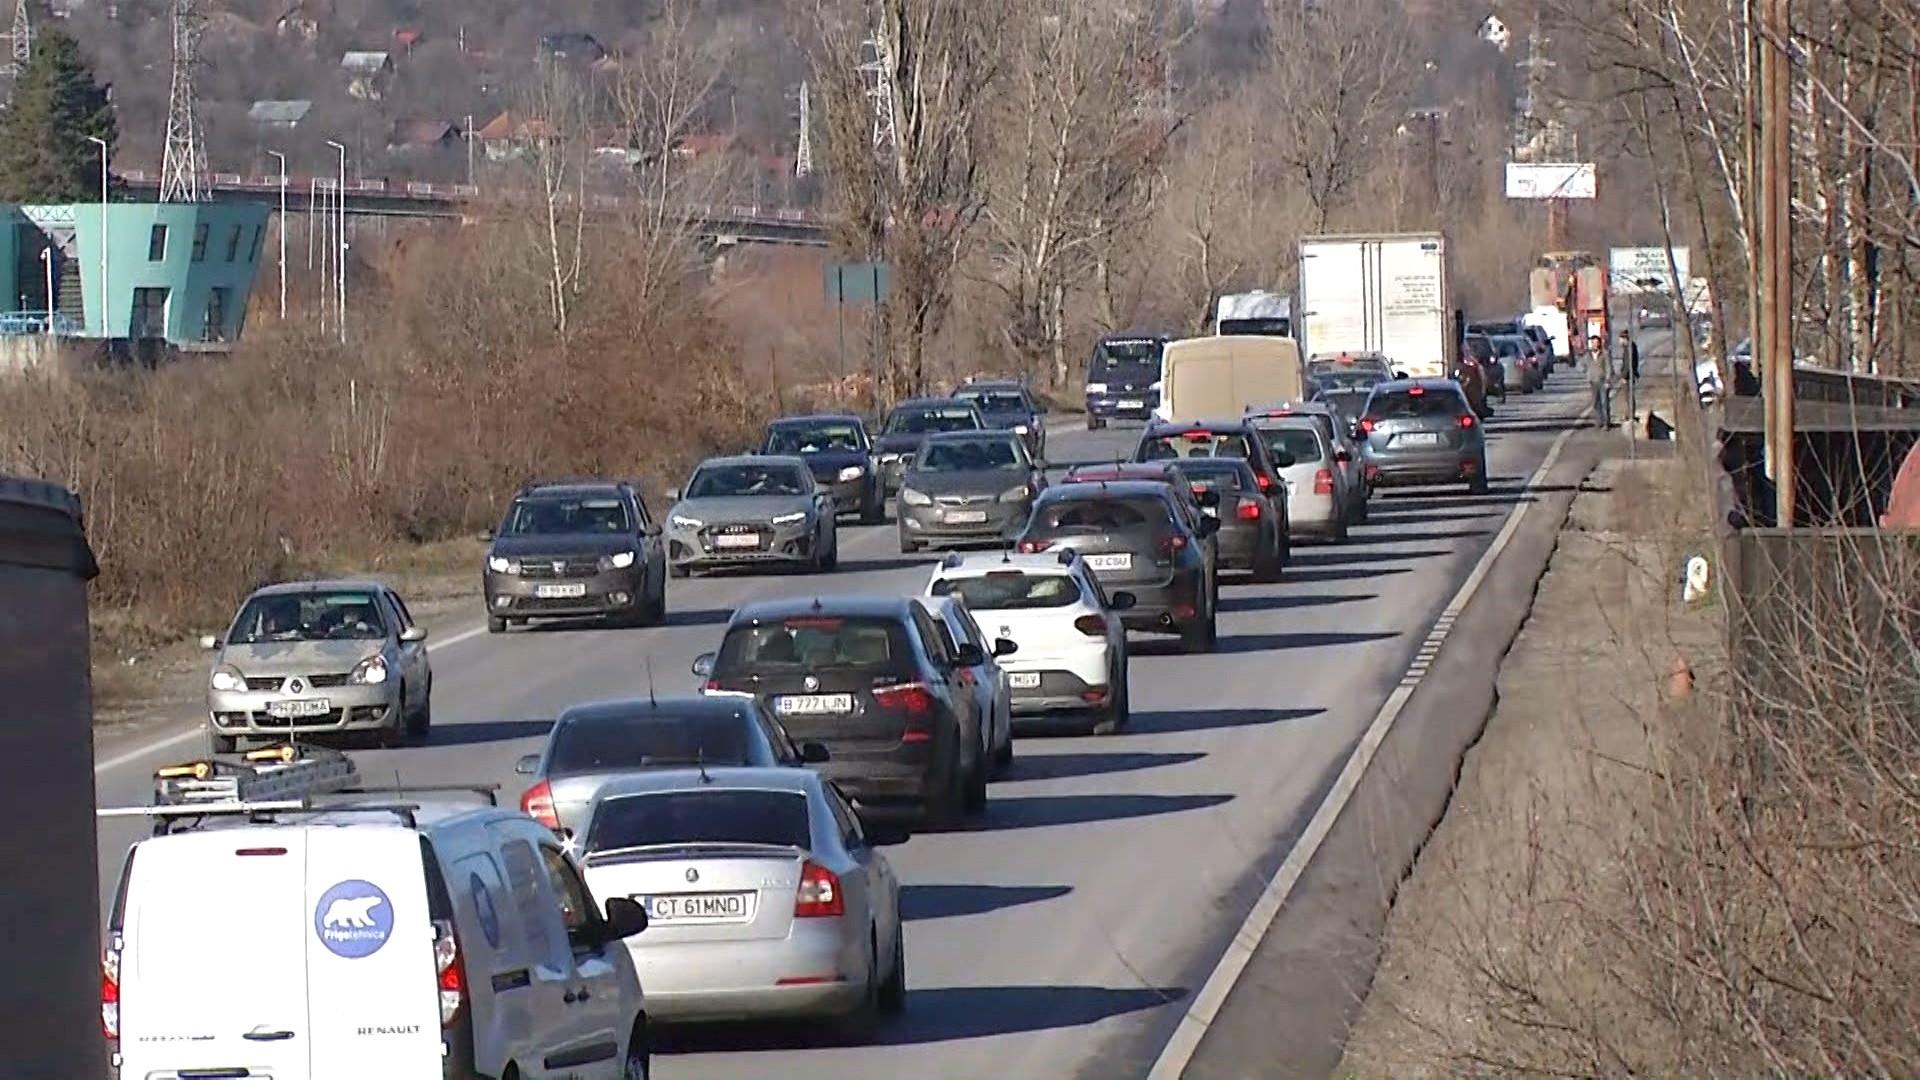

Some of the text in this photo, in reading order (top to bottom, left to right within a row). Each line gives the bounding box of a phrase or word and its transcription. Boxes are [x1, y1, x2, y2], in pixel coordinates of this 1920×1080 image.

[783, 699, 793, 710] B
[796, 699, 820, 710] 777
[656, 896, 740, 916] CT 61 MND
[358, 1025, 421, 1036] RENAULT
